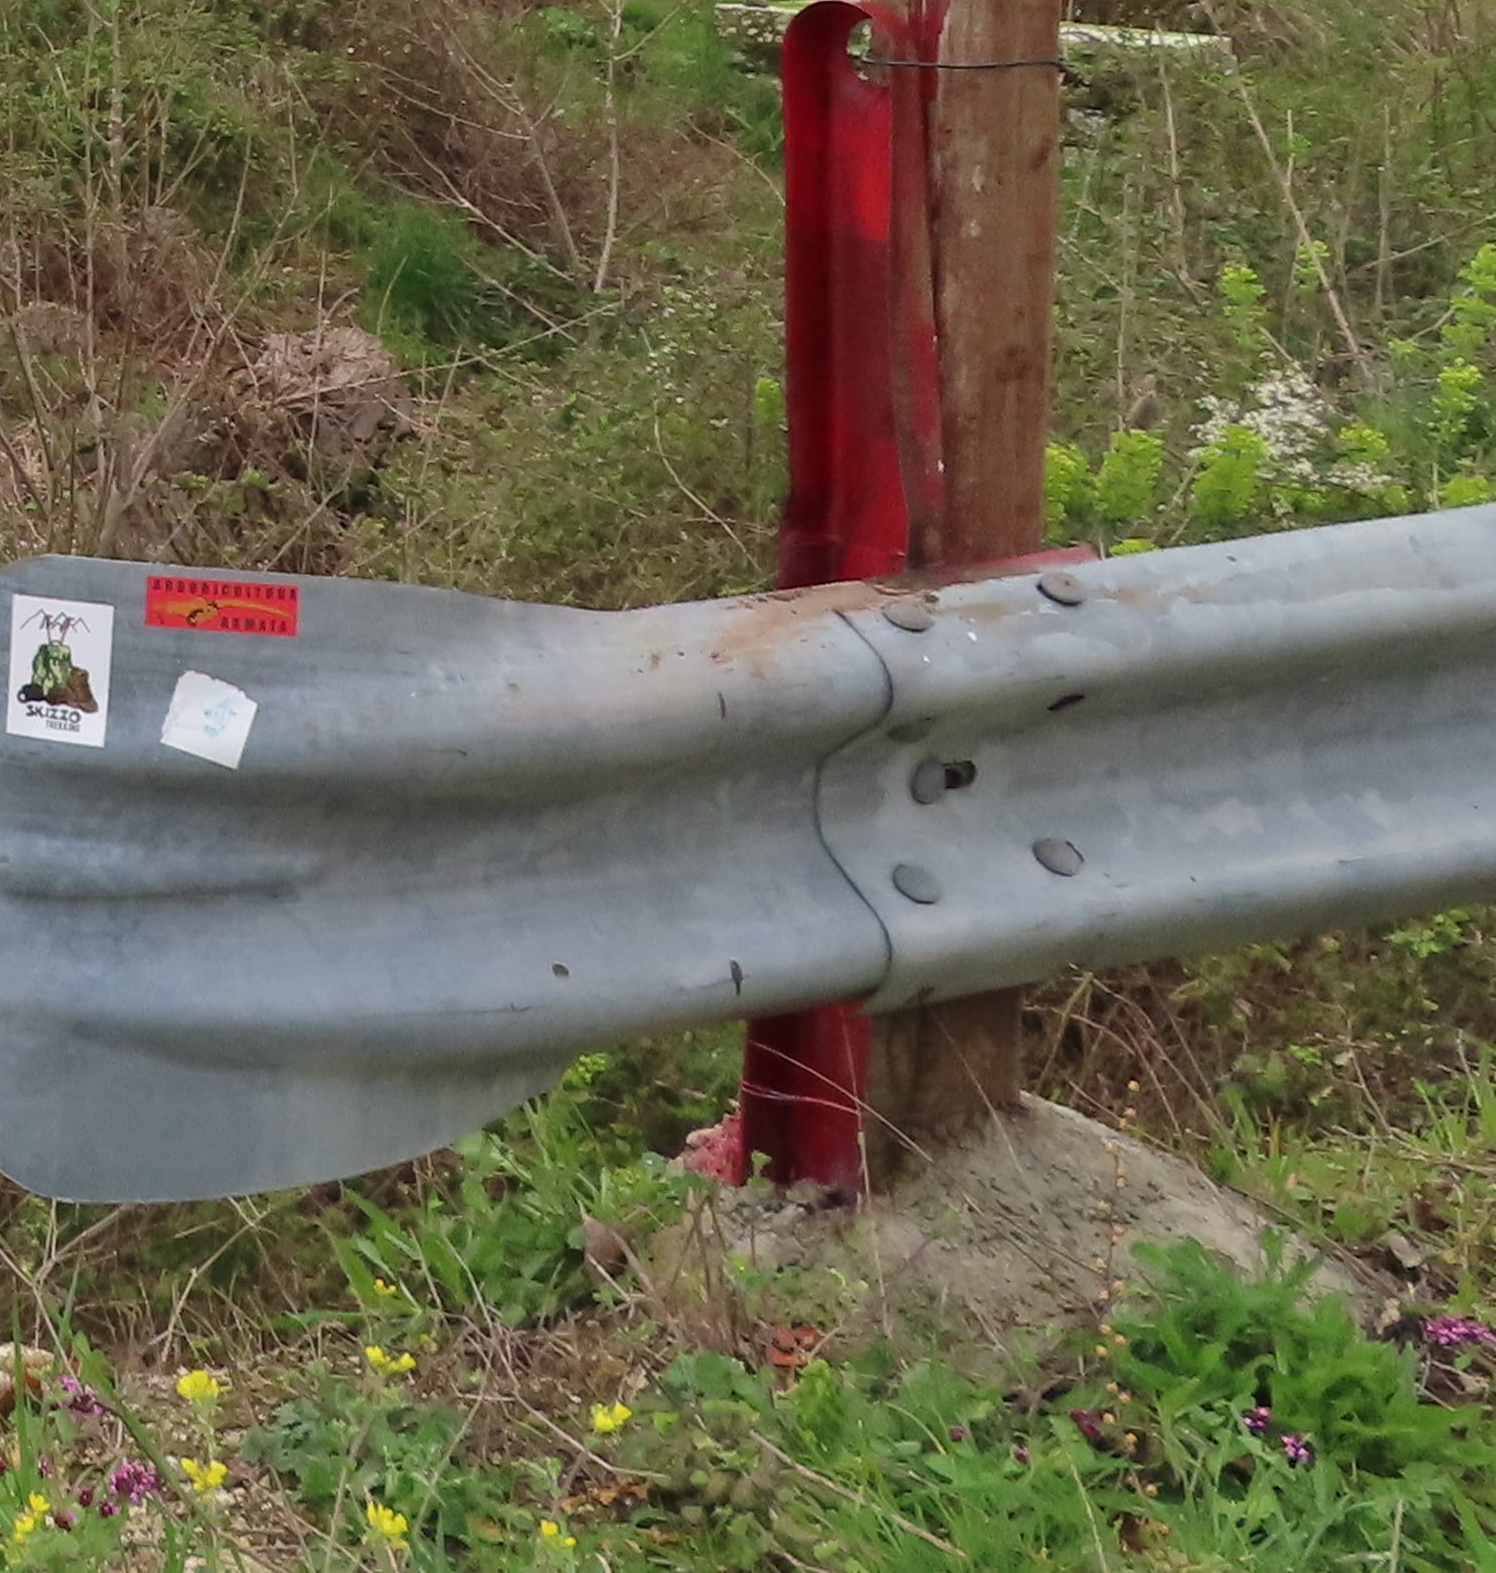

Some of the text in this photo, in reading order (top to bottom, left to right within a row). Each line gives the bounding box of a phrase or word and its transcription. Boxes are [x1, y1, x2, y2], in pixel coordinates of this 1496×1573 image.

[152, 579, 298, 600] ARBORICOLTURA
[220, 616, 287, 632] ARMATA
[26, 705, 82, 723] SKIZZO
